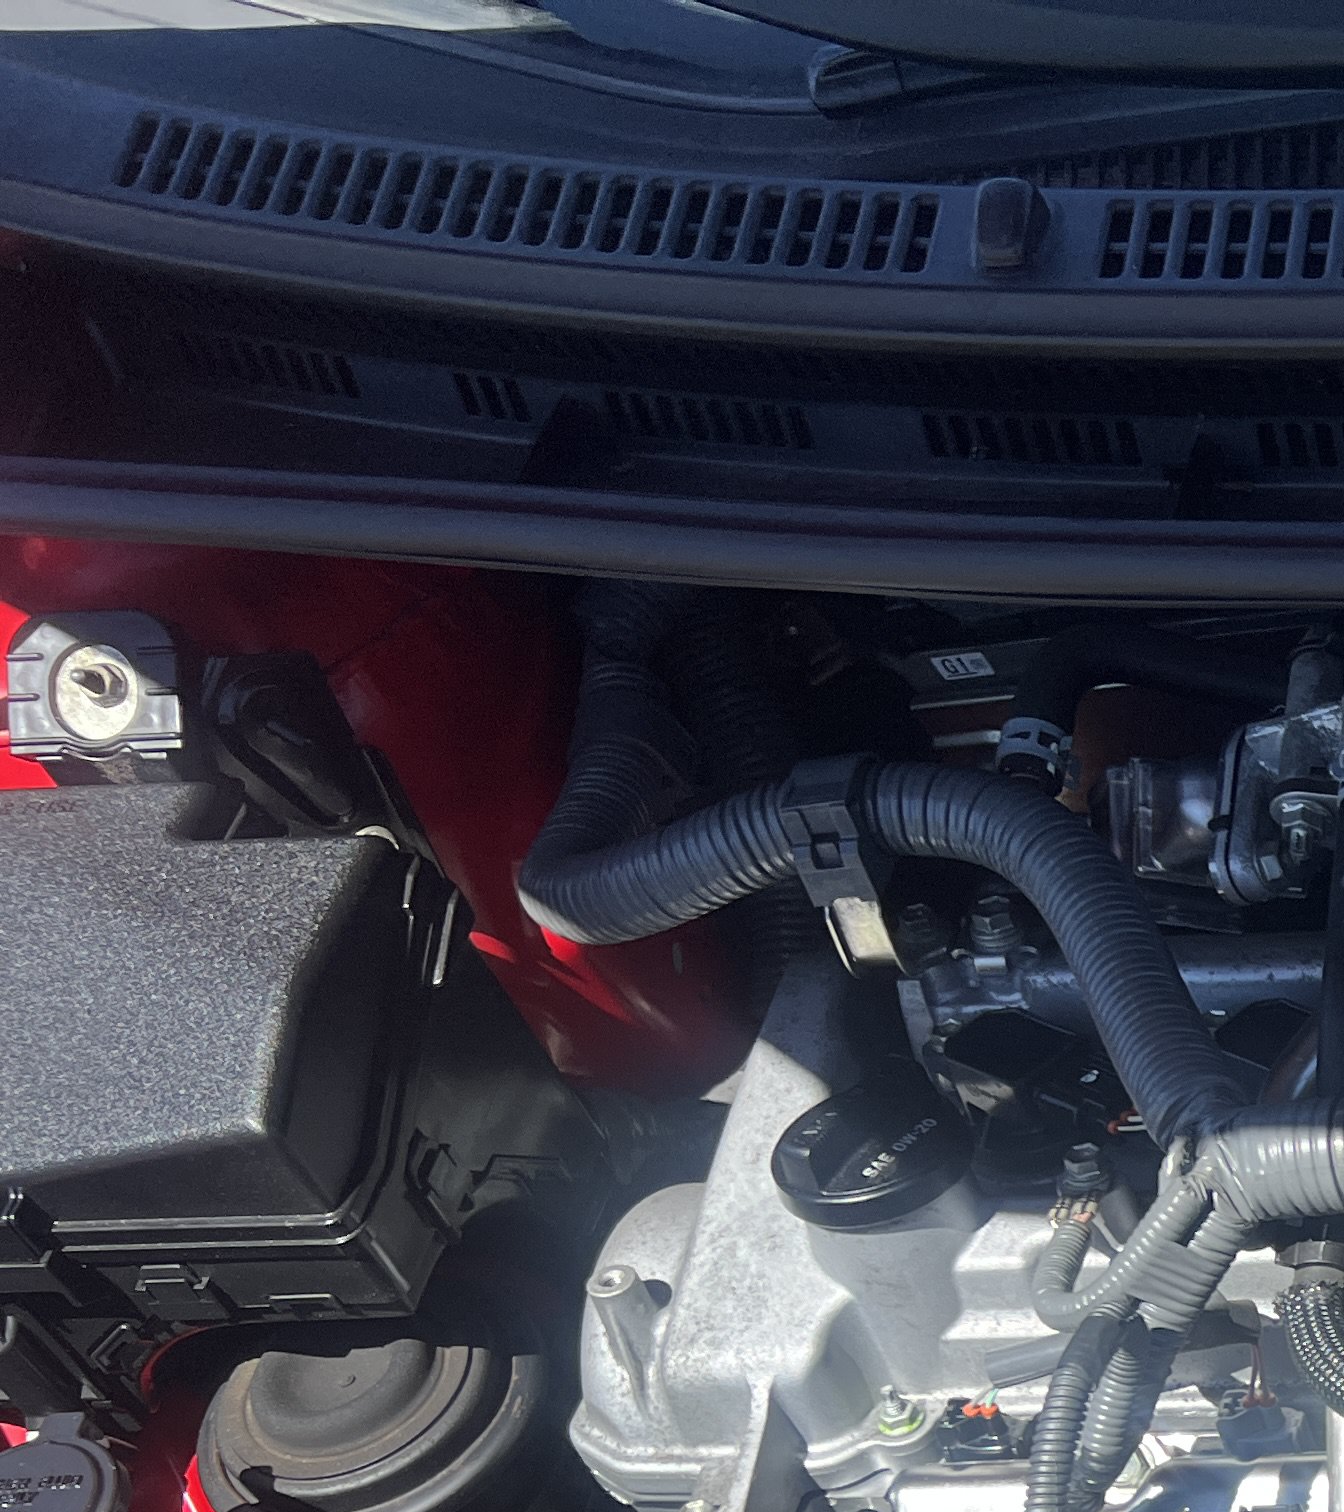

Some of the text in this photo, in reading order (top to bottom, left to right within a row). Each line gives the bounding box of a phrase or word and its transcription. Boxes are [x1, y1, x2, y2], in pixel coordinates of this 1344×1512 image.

[941, 658, 969, 674] G1
[861, 1118, 938, 1178] SAE 0W-20
